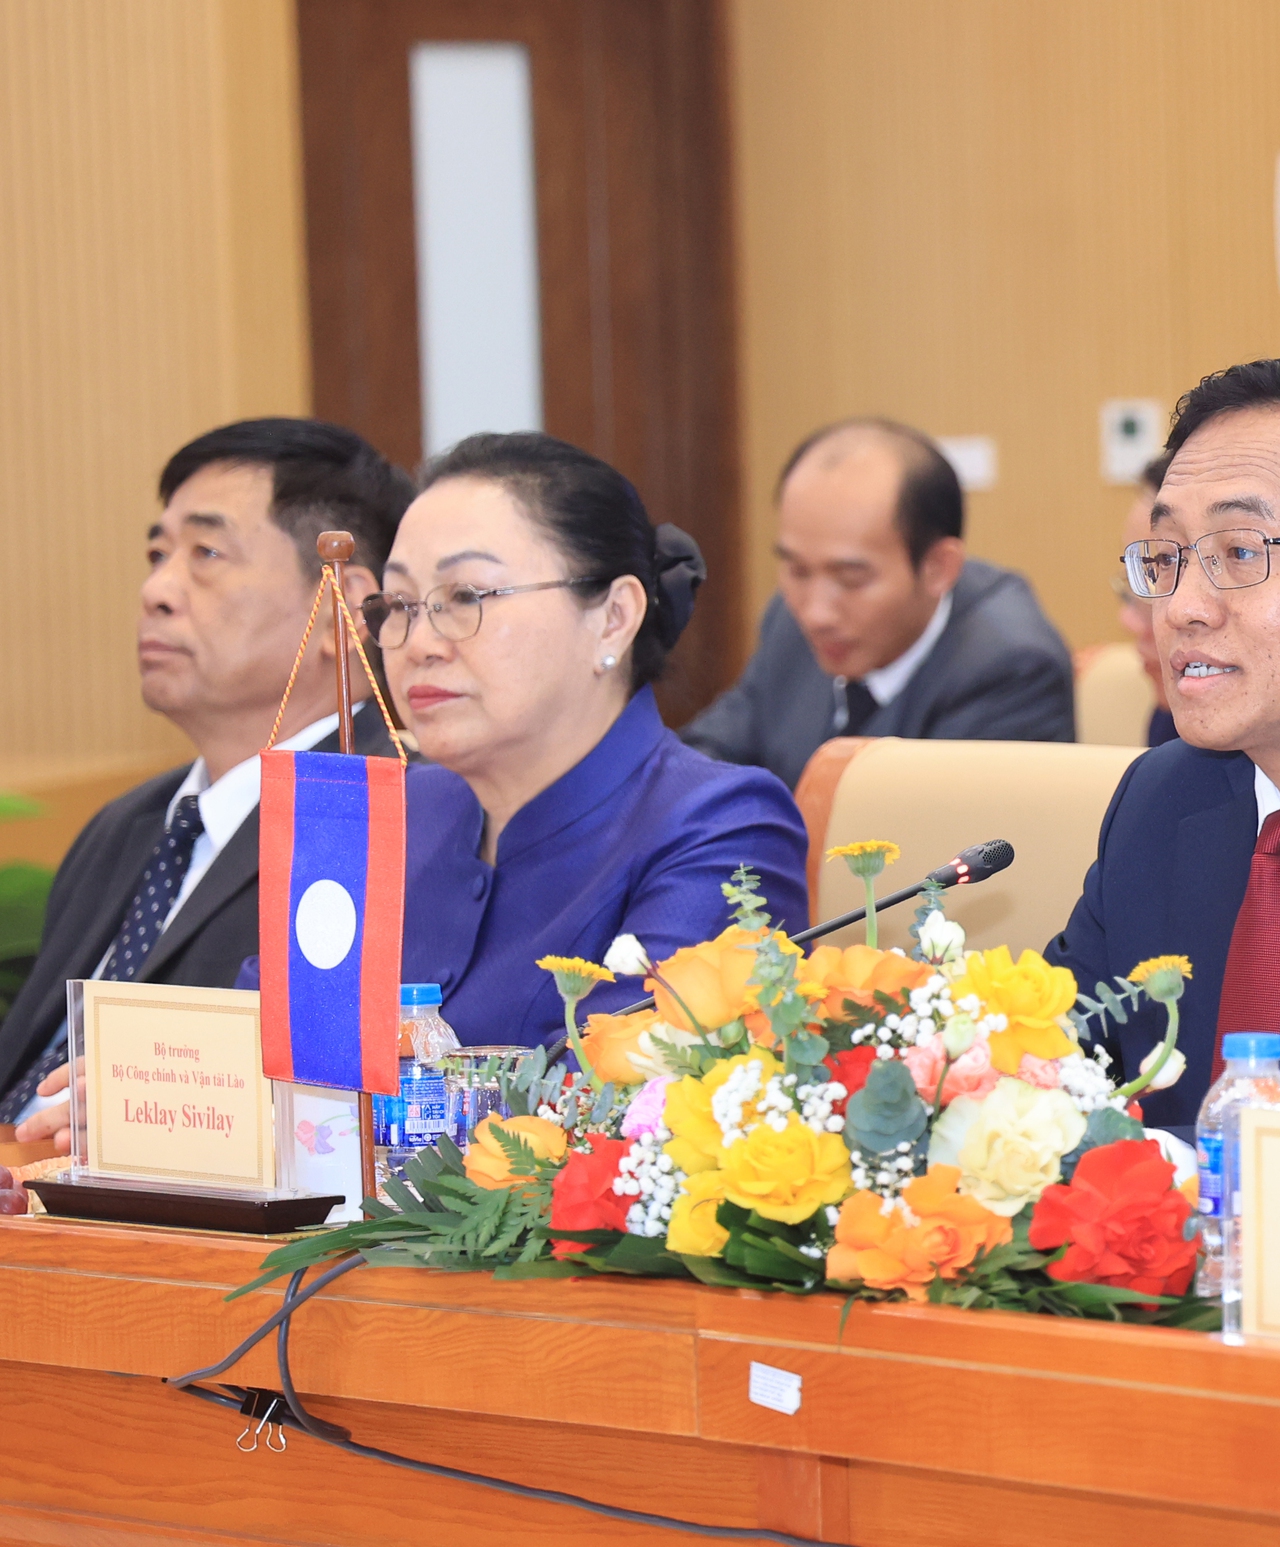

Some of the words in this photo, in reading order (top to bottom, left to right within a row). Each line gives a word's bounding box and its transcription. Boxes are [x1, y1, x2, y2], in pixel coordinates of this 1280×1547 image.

[153, 1042, 166, 1060] Bộ
[168, 1044, 200, 1063] trưởng
[112, 1064, 125, 1082] Bộ
[126, 1065, 150, 1085] Công
[151, 1068, 177, 1083] chính
[179, 1070, 190, 1085] và
[192, 1070, 211, 1089] Vận
[227, 1074, 245, 1090] Lào
[124, 1098, 177, 1133] Leklay
[181, 1103, 235, 1138] Sivilay
